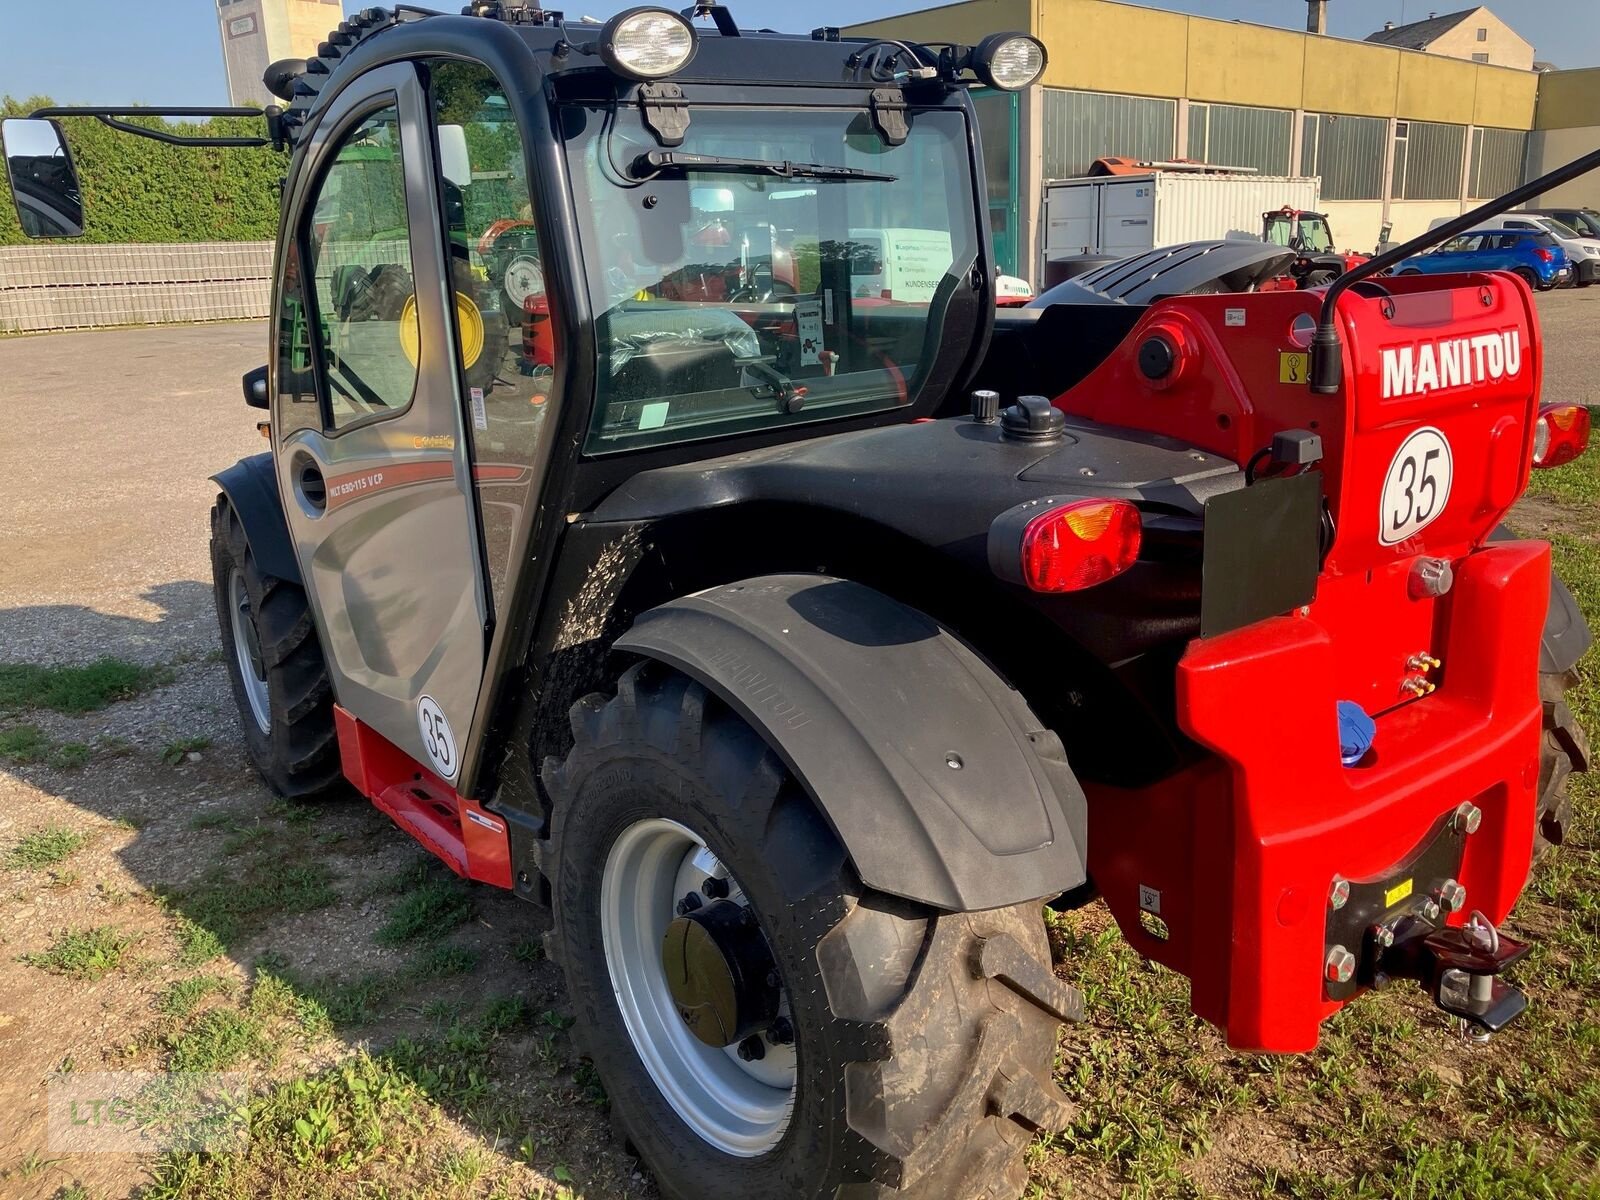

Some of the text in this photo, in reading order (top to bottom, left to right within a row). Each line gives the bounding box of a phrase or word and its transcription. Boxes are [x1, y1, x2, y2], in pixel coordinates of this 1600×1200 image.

[1382, 330, 1521, 399] MANITOU
[330, 485, 341, 497] MLT
[1392, 448, 1440, 530] 35
[709, 649, 813, 731] MANITOU
[422, 707, 450, 767] 35
